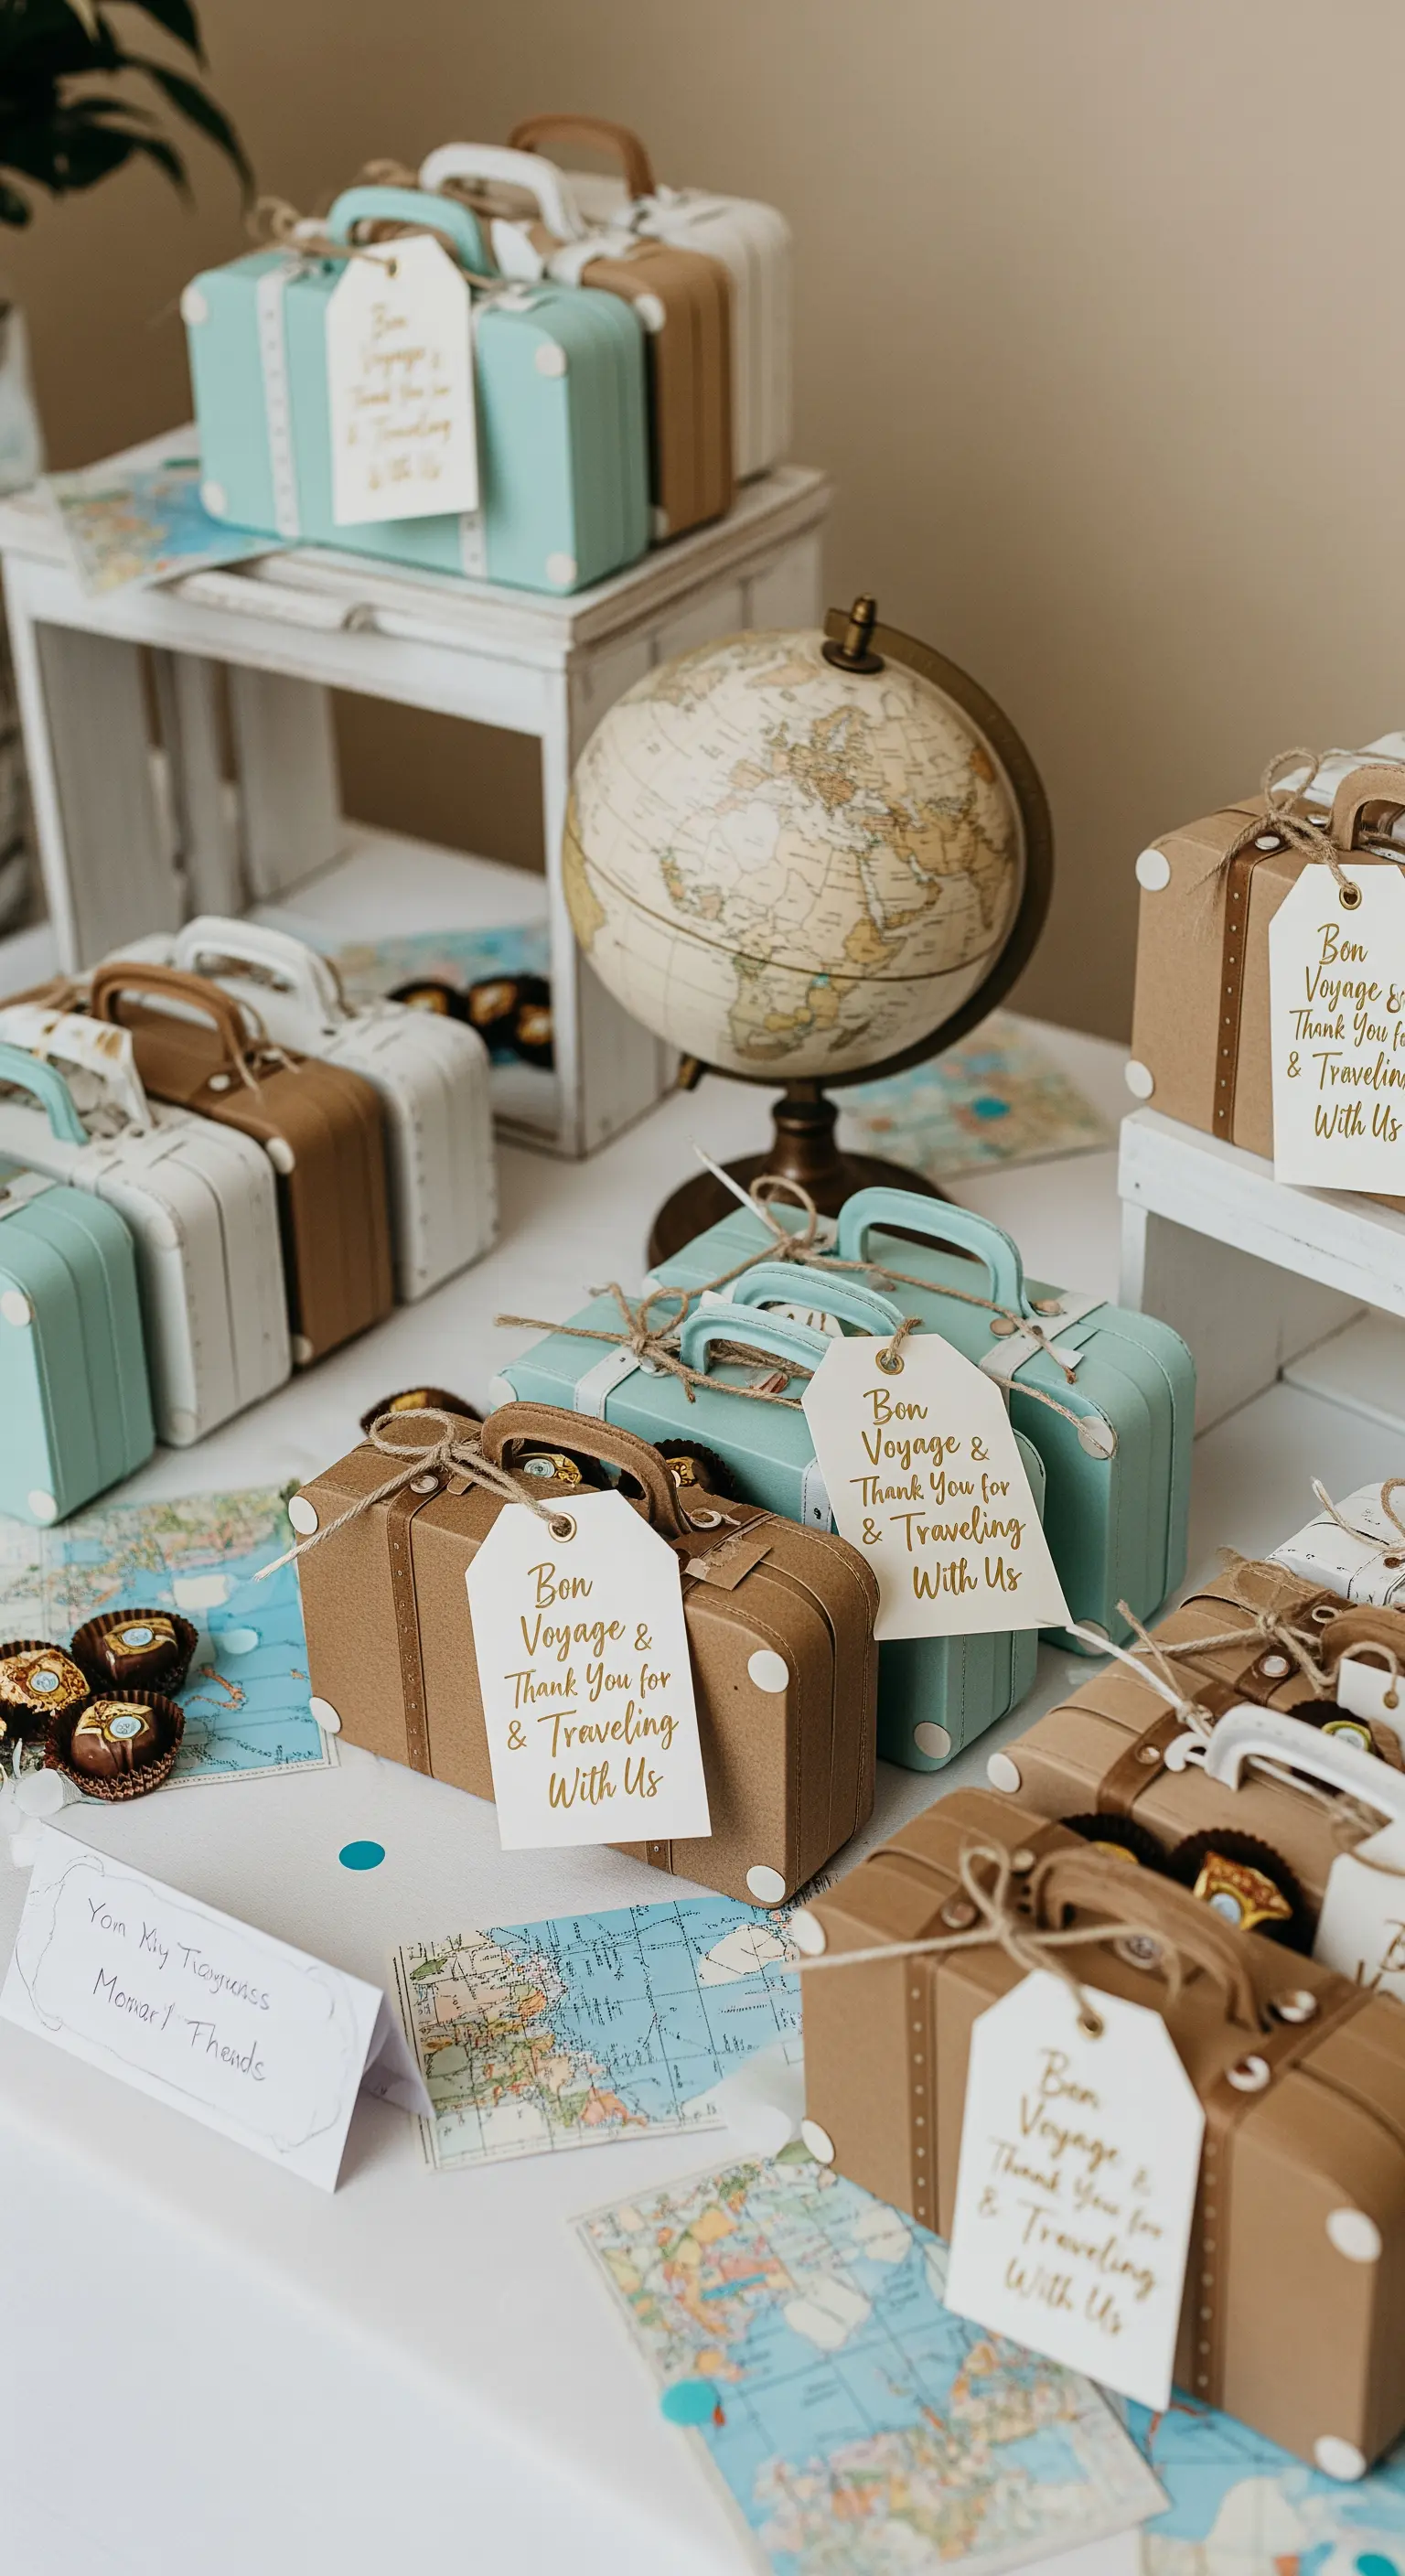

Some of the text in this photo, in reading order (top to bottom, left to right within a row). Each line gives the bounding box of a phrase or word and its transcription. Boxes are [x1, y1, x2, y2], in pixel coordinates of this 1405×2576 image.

[1317, 923, 1368, 965] Bon
[1305, 965, 1405, 1014] Voyage &
[1289, 1008, 1405, 1051] Thank You fo
[1287, 1051, 1405, 1090] & Travelin
[1314, 1100, 1402, 1142] With Us
[863, 1388, 928, 1425] Bon
[862, 1428, 991, 1471] Voyage &
[850, 1471, 1010, 1508] Thank You for
[862, 1505, 1026, 1552] & Traveling
[527, 1562, 593, 1609] Bon
[913, 1556, 1023, 1600] With Us
[520, 1613, 653, 1662] Voyage &
[504, 1662, 671, 1709] Thank You for
[507, 1700, 680, 1757] & Traveling
[549, 1756, 664, 1809] With Us
[1038, 2046, 1100, 2109] Bon
[1019, 2093, 1119, 2173] Voyage
[988, 2135, 1164, 2238] Thank You for
[979, 2184, 1156, 2302] & Traveling
[1004, 2257, 1122, 2335] With Us
